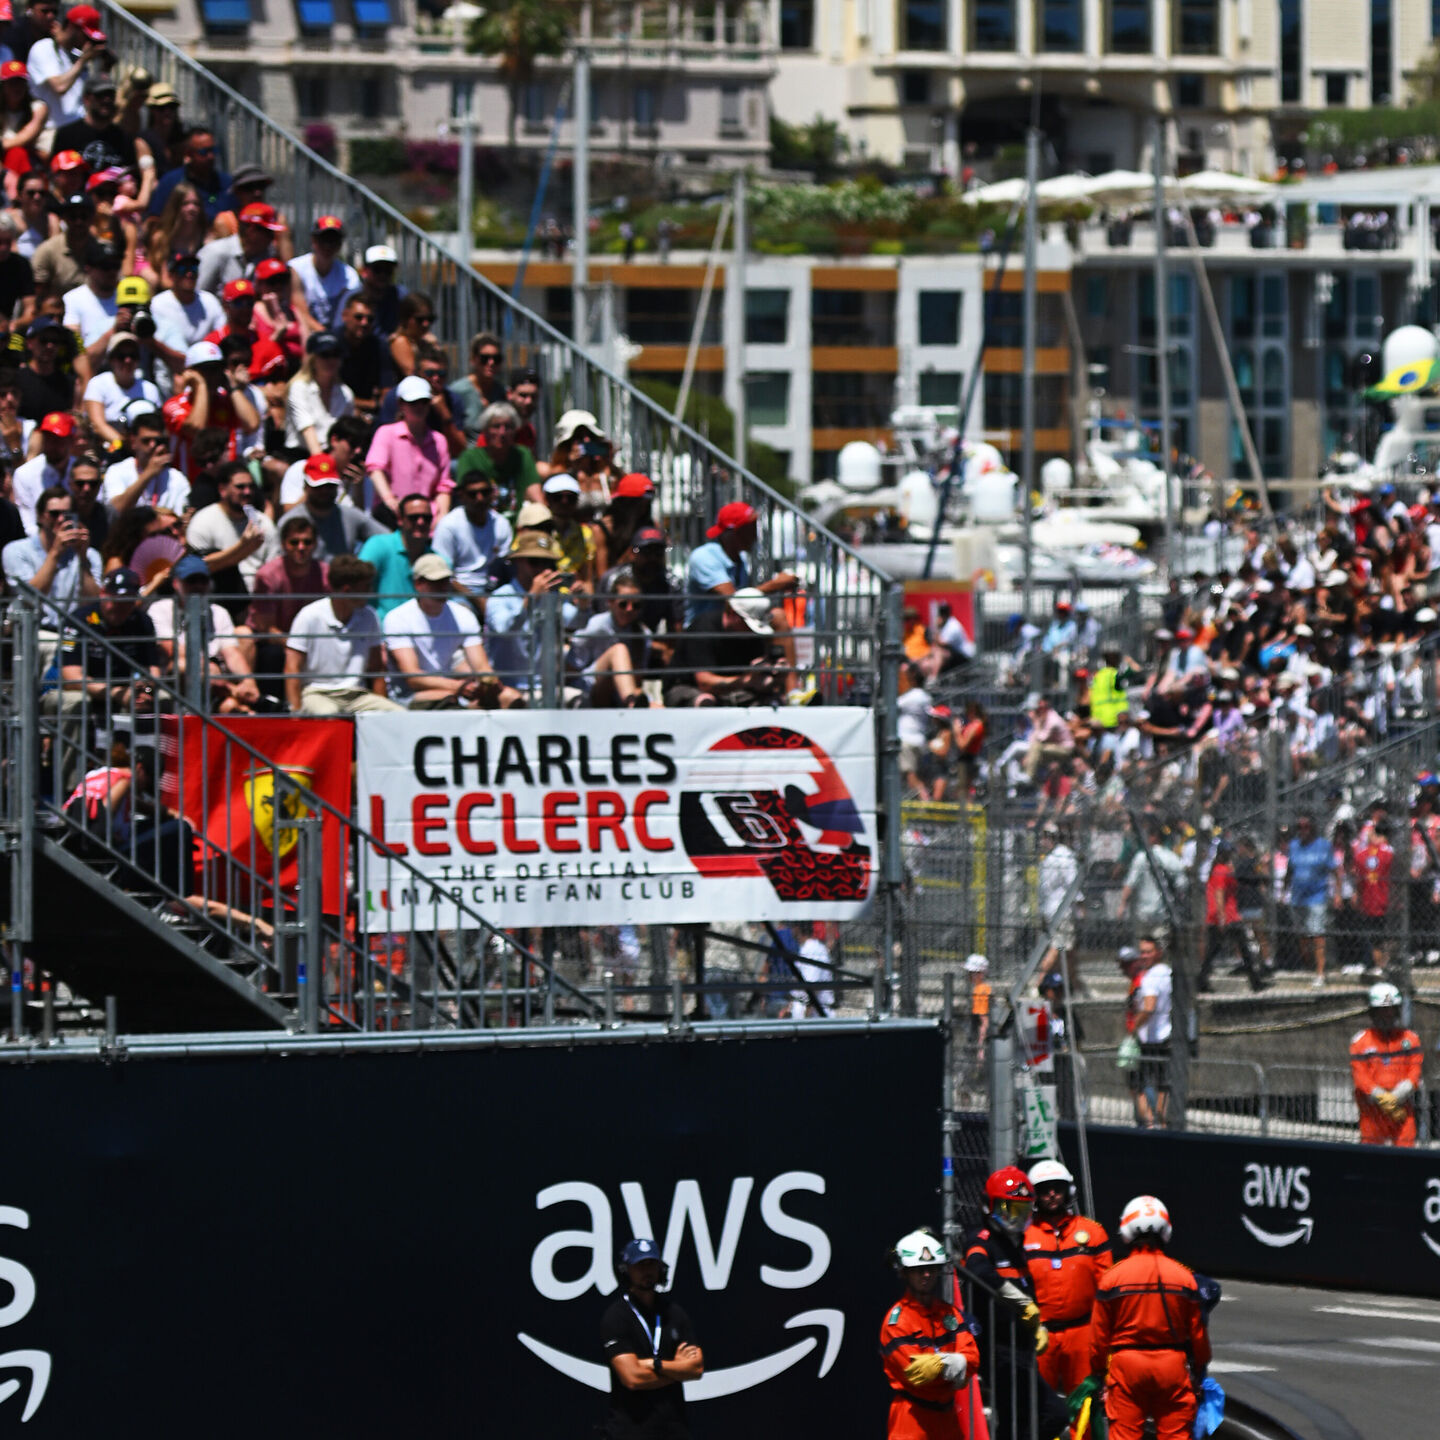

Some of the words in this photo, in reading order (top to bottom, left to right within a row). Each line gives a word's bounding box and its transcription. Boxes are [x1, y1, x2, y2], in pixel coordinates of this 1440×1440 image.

[413, 734, 677, 786] CHARLES
[370, 789, 675, 857] LECLERC
[401, 882, 527, 906] MARCHE
[547, 882, 602, 902] FAN
[621, 879, 695, 899] CLUB
[441, 863, 496, 882] THE
[516, 859, 656, 882] OFFICIAL
[1244, 1162, 1311, 1212] aws
[531, 1171, 832, 1301] aws
